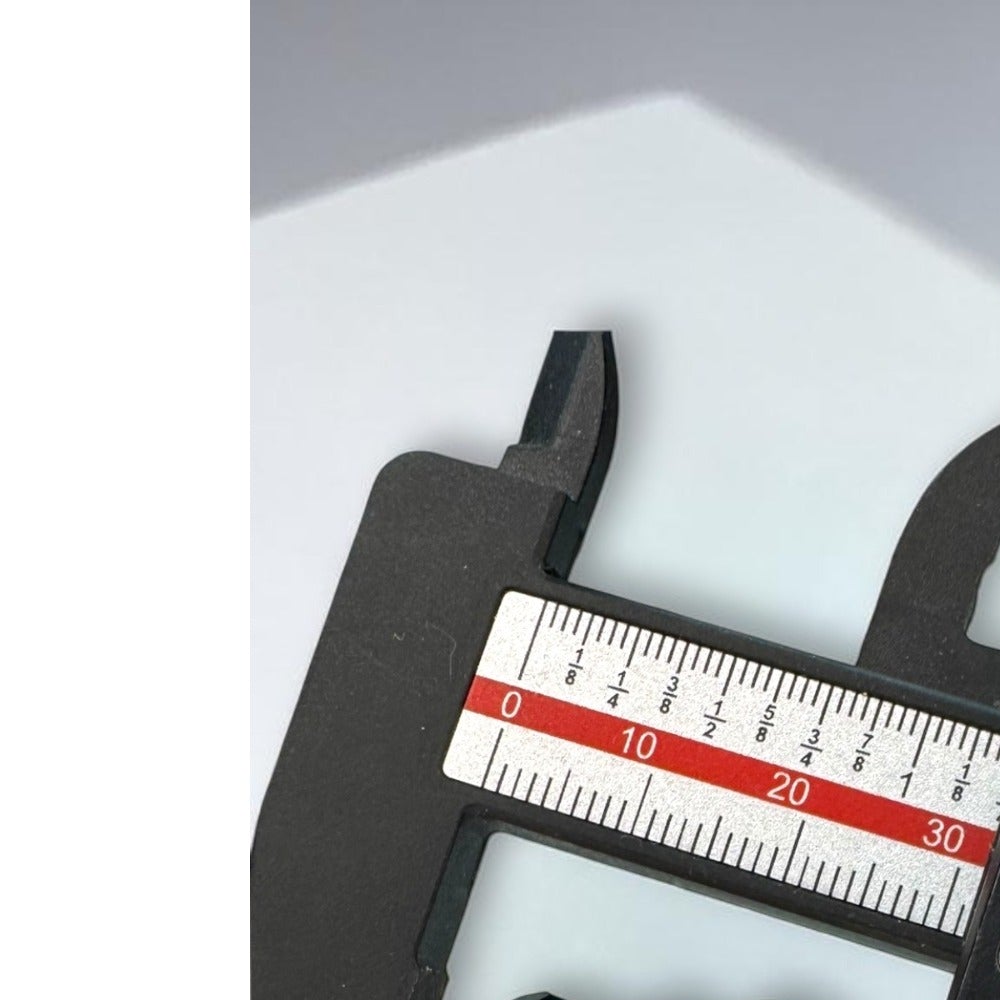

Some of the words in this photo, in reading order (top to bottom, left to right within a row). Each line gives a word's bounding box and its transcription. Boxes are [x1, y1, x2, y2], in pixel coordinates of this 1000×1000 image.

[501, 691, 522, 719] 0
[622, 727, 657, 760] 10
[767, 771, 810, 806] 20
[923, 818, 964, 853] 30
[900, 771, 914, 798] 1
